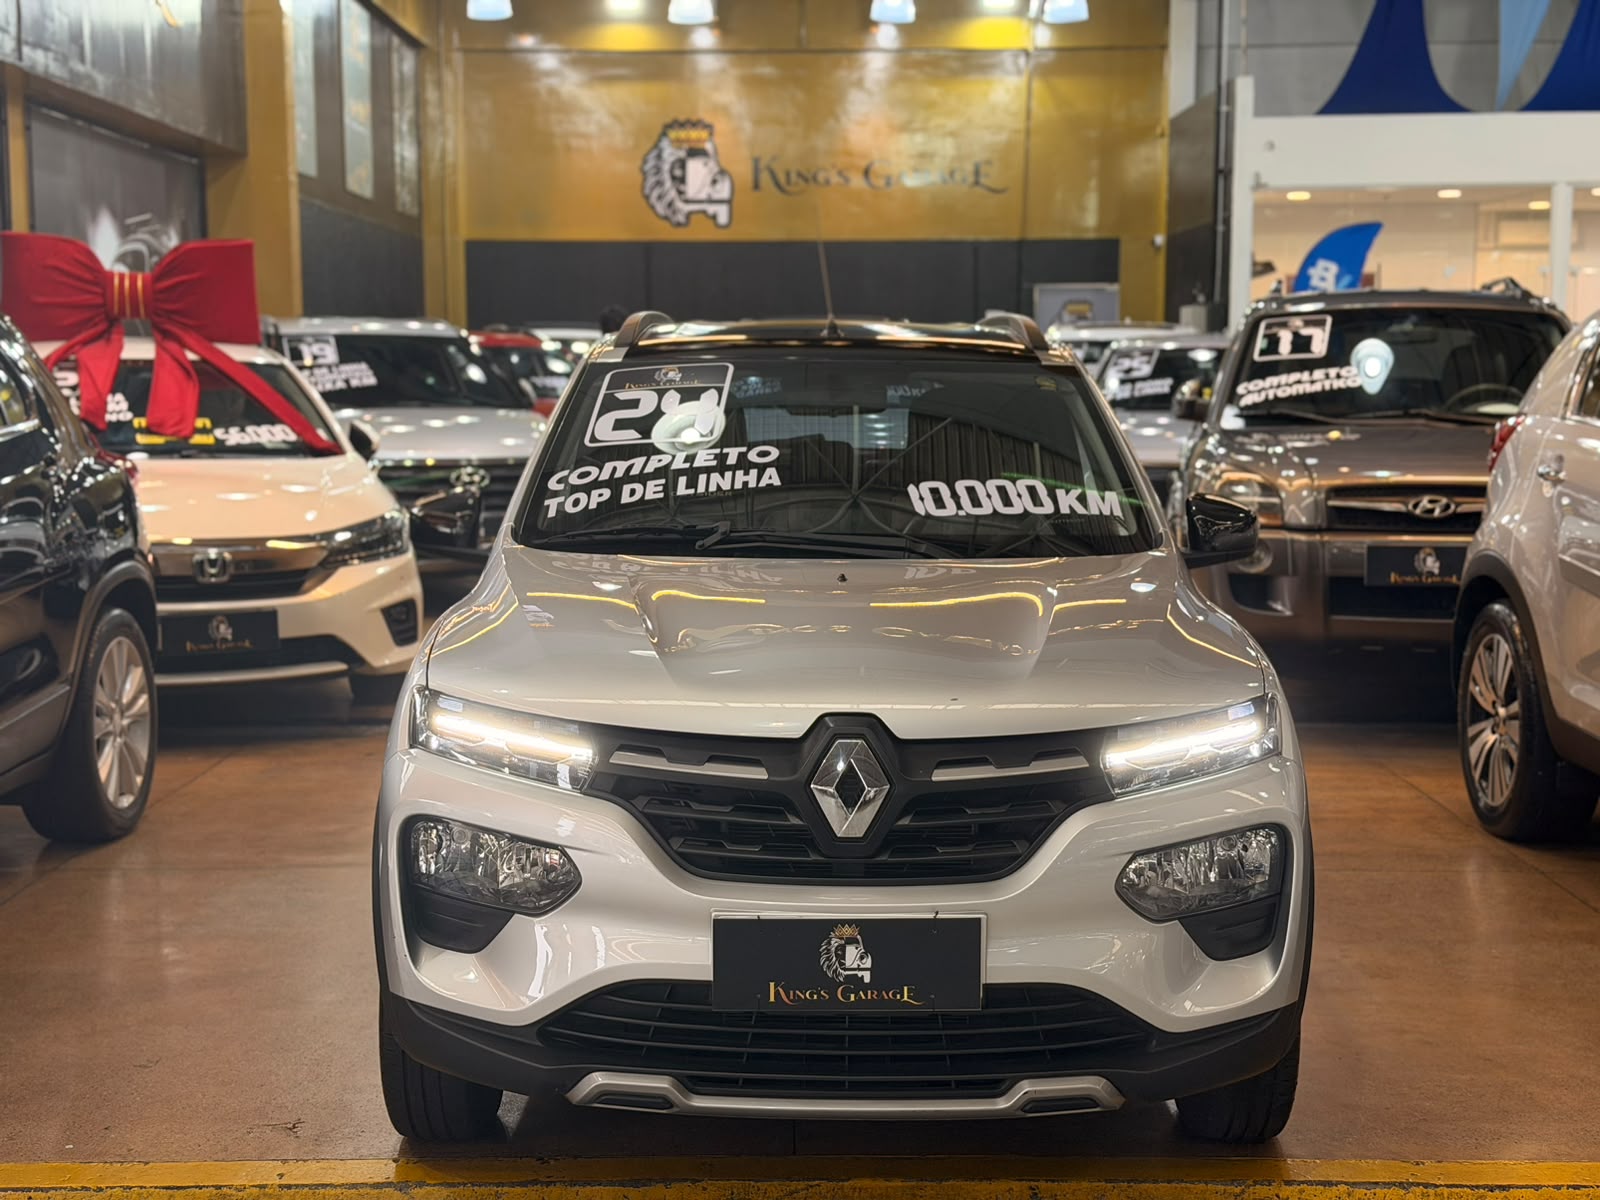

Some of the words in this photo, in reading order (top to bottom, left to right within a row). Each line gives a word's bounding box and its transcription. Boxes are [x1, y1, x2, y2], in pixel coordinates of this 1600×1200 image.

[751, 156, 851, 196] KING'S
[1236, 365, 1358, 395] COMPLETO
[593, 387, 719, 442] 24
[547, 445, 780, 491] COMPLETO
[543, 486, 611, 518] TOP
[620, 479, 666, 505] DE
[676, 466, 782, 496] LINHA
[907, 479, 1055, 516] 10.000
[1055, 488, 1125, 521] KM
[768, 981, 829, 1005] KING'S
[837, 985, 926, 1005] GARAGE
